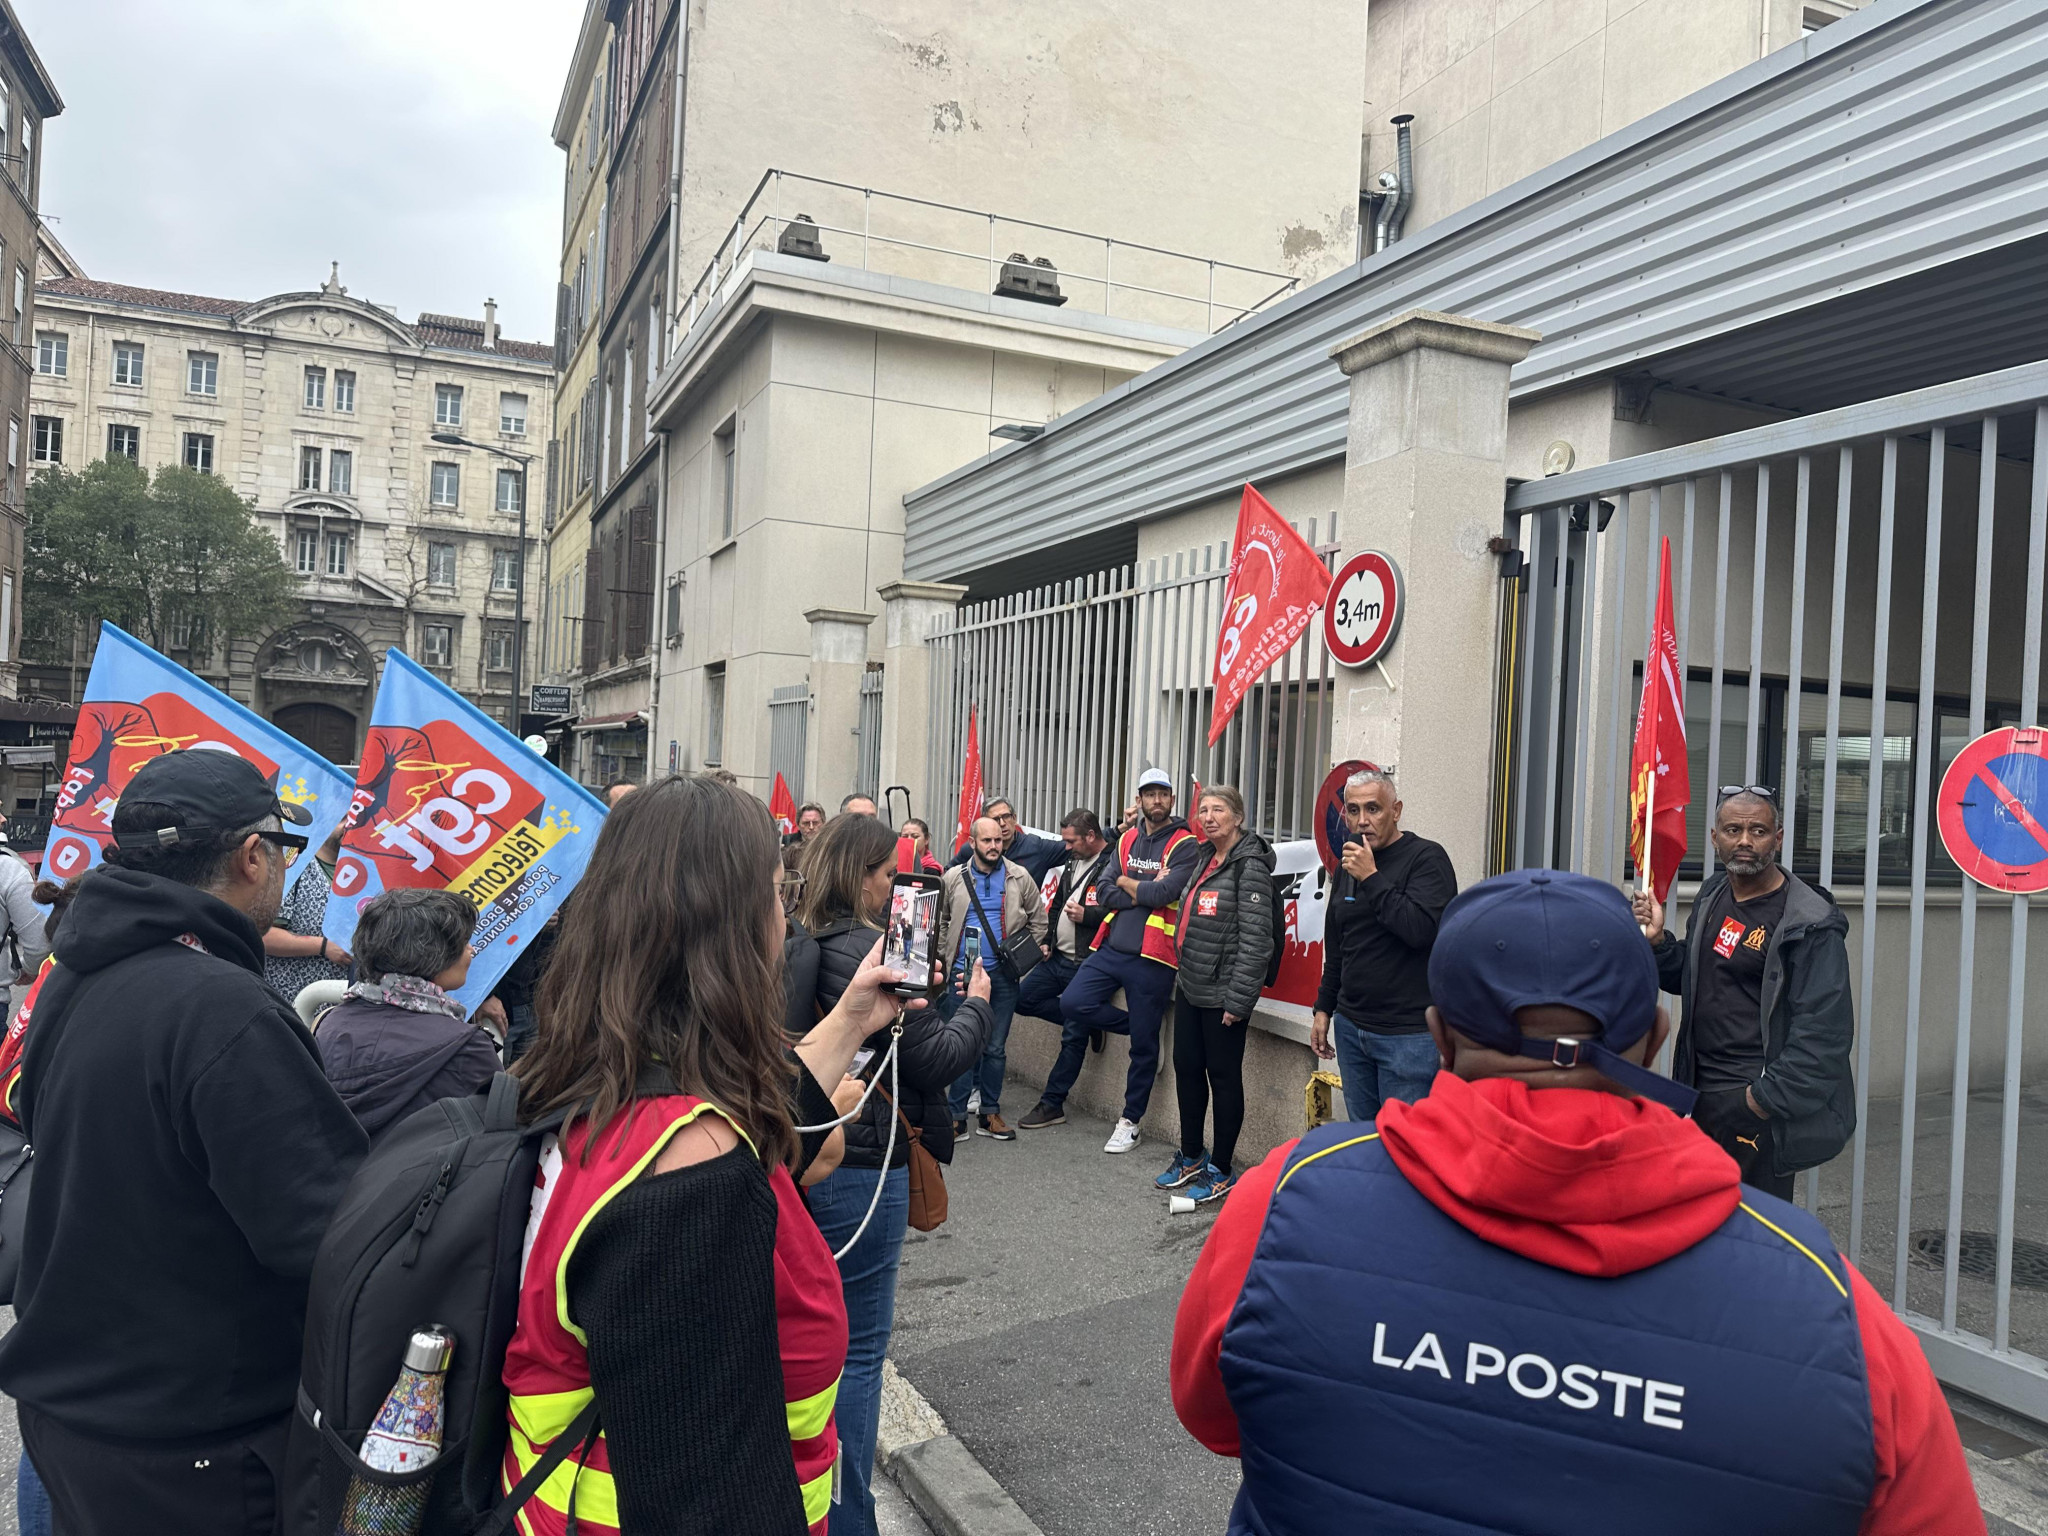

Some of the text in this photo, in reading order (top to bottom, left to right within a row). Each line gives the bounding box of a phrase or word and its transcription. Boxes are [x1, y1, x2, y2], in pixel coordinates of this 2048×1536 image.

[1336, 598, 1380, 628] 3,4m
[1086, 891, 1097, 901] cg
[1198, 896, 1218, 909] cgt
[1284, 908, 1296, 923] GT
[1719, 927, 1741, 946] cgt
[1372, 1322, 1685, 1430] LA POSTE
